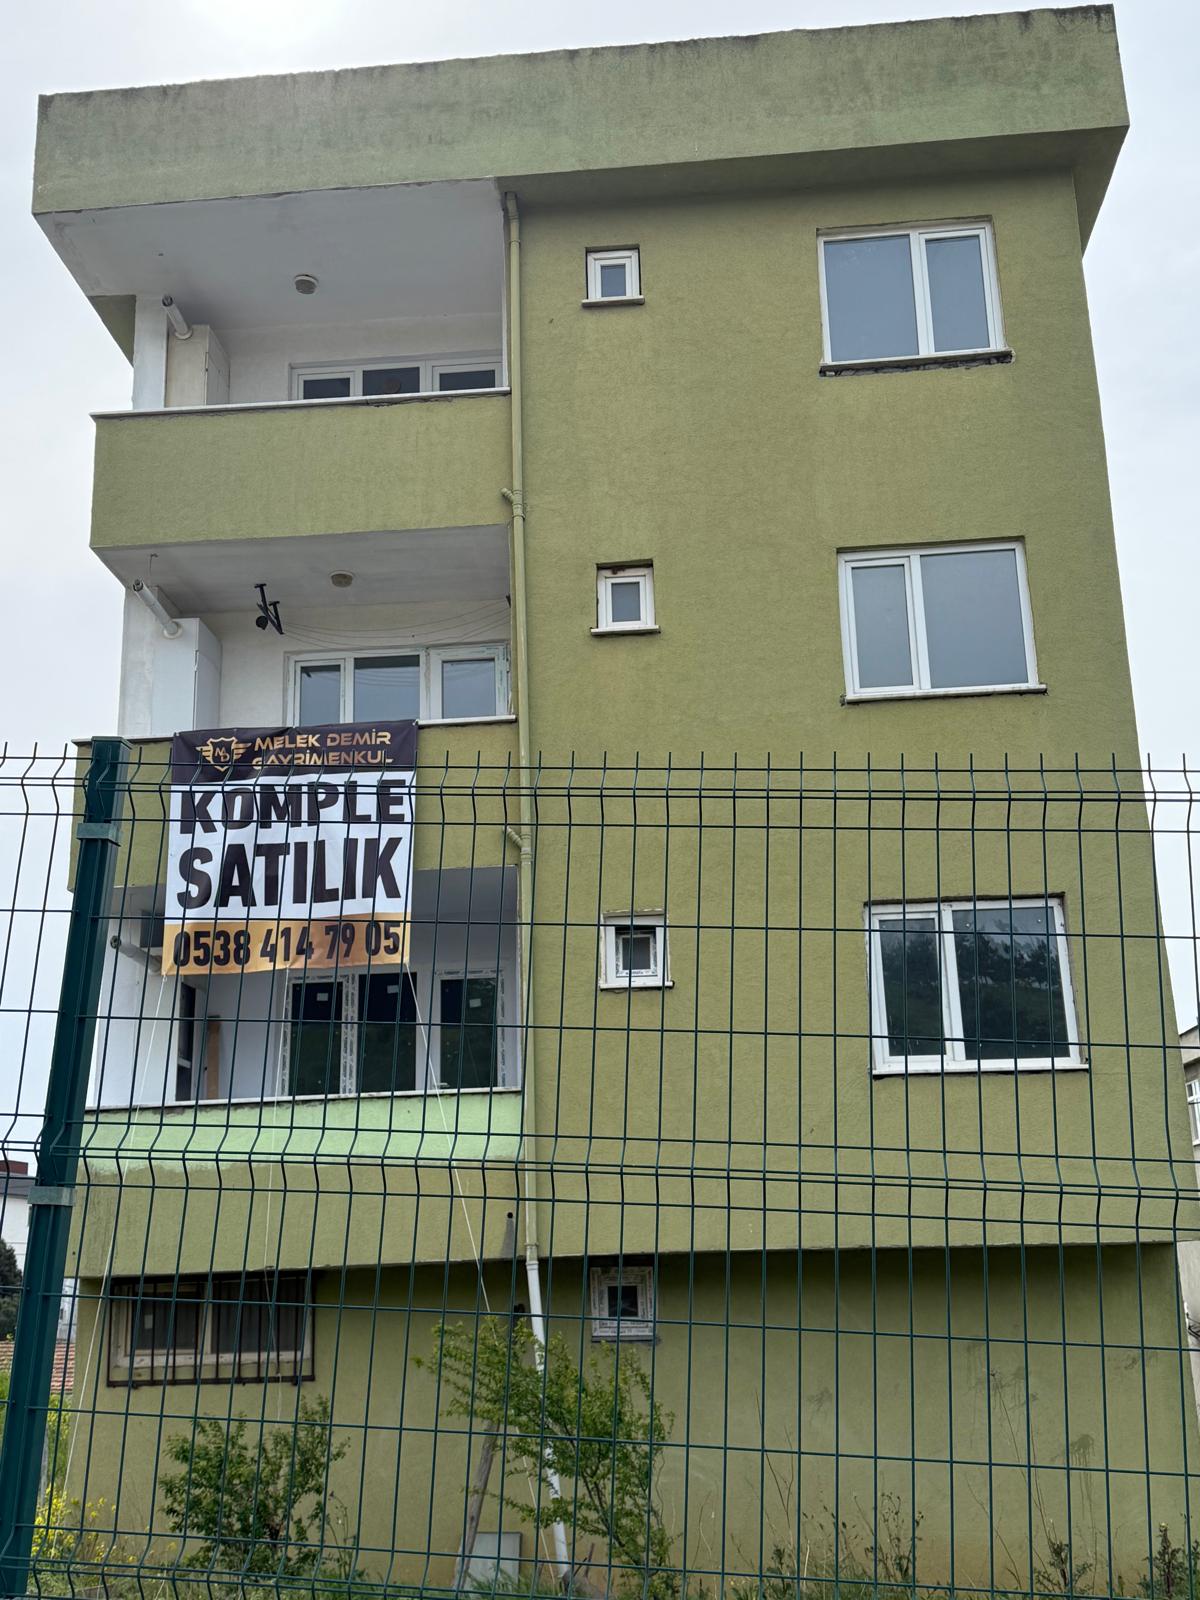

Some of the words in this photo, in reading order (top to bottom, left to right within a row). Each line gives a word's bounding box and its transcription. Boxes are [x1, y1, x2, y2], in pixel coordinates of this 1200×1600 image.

[254, 733, 320, 751] MELEK
[327, 728, 392, 747] DEMİR
[179, 779, 406, 835] KOMPLE
[176, 837, 403, 910] SATILIK
[173, 930, 251, 967] 0538
[260, 926, 315, 963] 414
[324, 922, 356, 960] 79
[365, 921, 401, 956] 05
